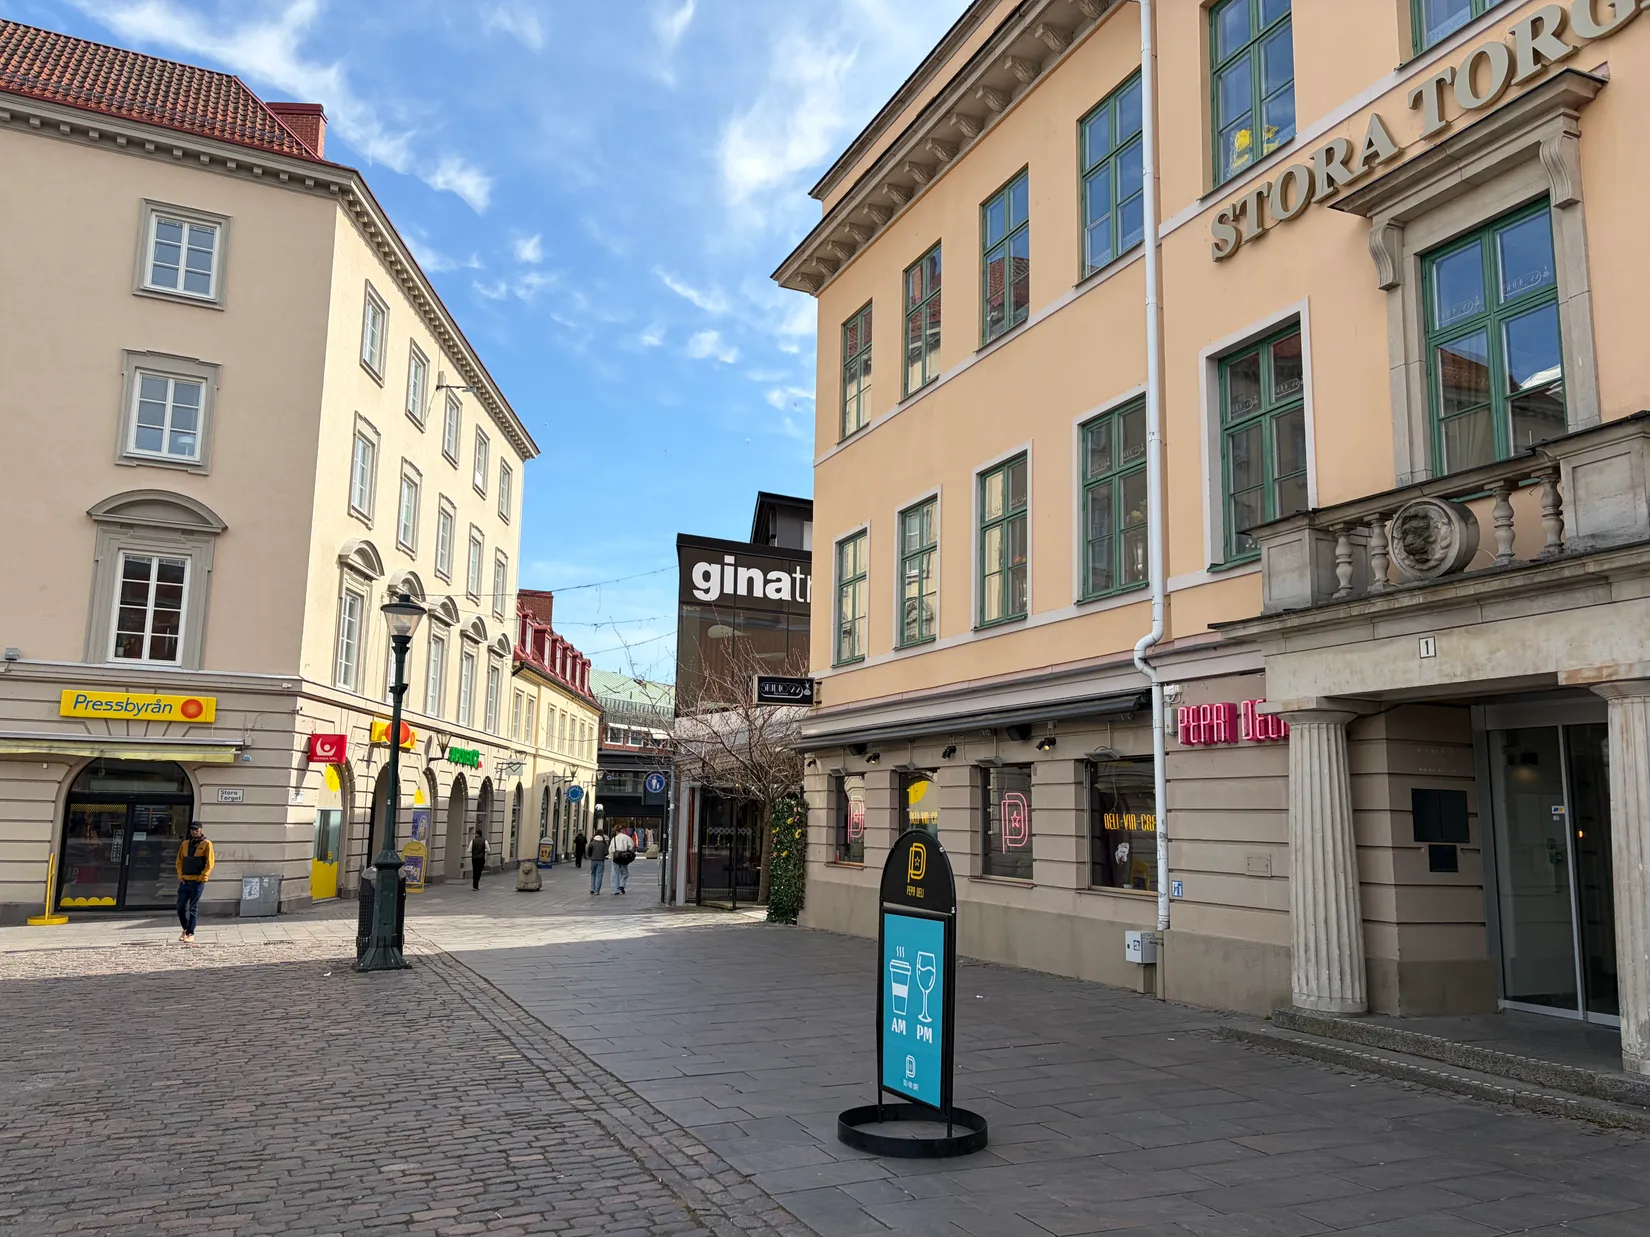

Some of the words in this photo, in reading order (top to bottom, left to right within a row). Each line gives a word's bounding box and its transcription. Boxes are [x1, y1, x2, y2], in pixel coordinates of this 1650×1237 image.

[1211, 112, 1401, 263] STORA
[1408, 0, 1650, 141] TORG
[1424, 639, 1430, 655] 1
[73, 694, 173, 717] Pressbyrån
[891, 1017, 906, 1035] AM
[916, 1024, 932, 1044] PM
